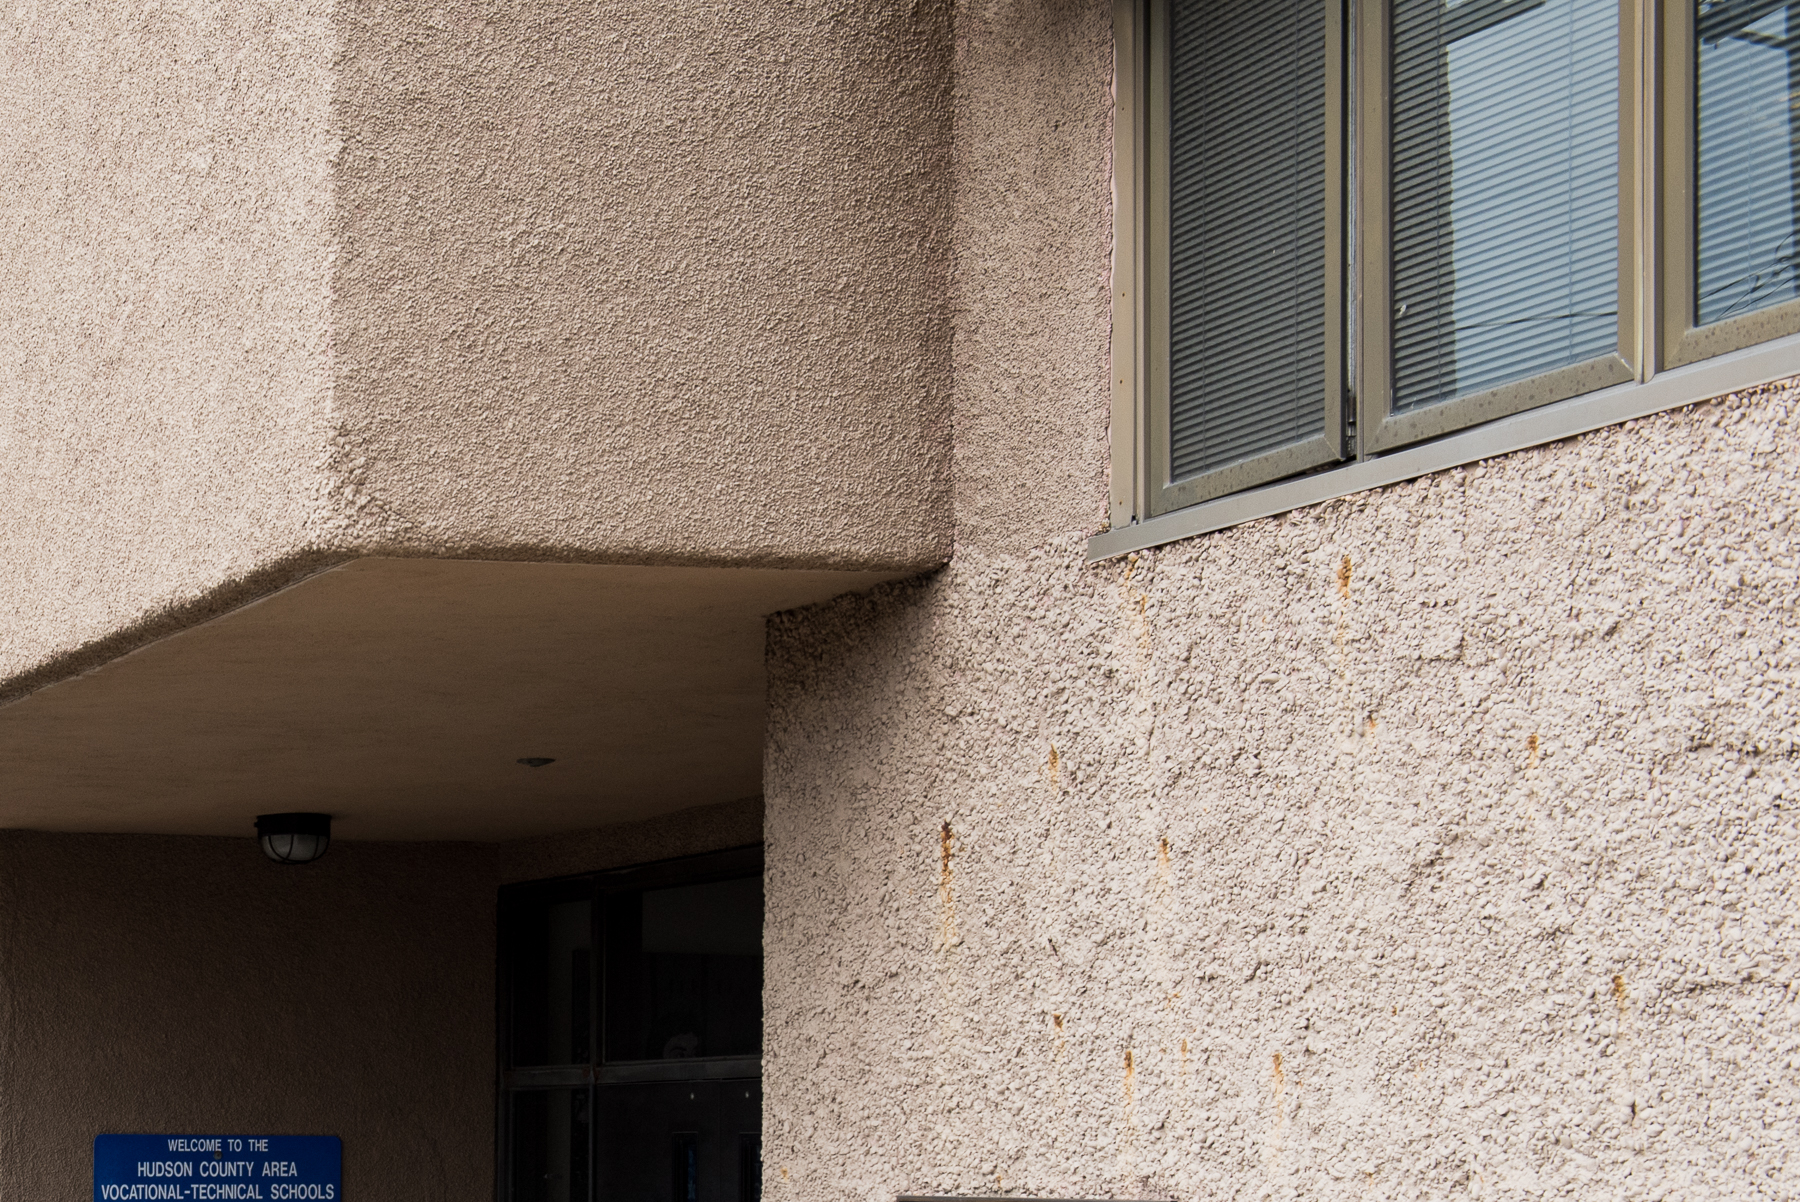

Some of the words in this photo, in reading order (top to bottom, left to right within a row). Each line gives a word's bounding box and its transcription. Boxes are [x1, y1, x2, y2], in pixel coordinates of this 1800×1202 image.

[168, 1139, 221, 1152] WELCOME
[228, 1139, 242, 1152] TO
[248, 1139, 268, 1152] THE
[137, 1162, 192, 1177] HUDSON
[200, 1162, 254, 1177] COUNTY
[262, 1162, 297, 1177] AREA
[101, 1184, 263, 1200] VOCATIONAL-TECHNICAL
[270, 1184, 334, 1200] SCHOOLS
